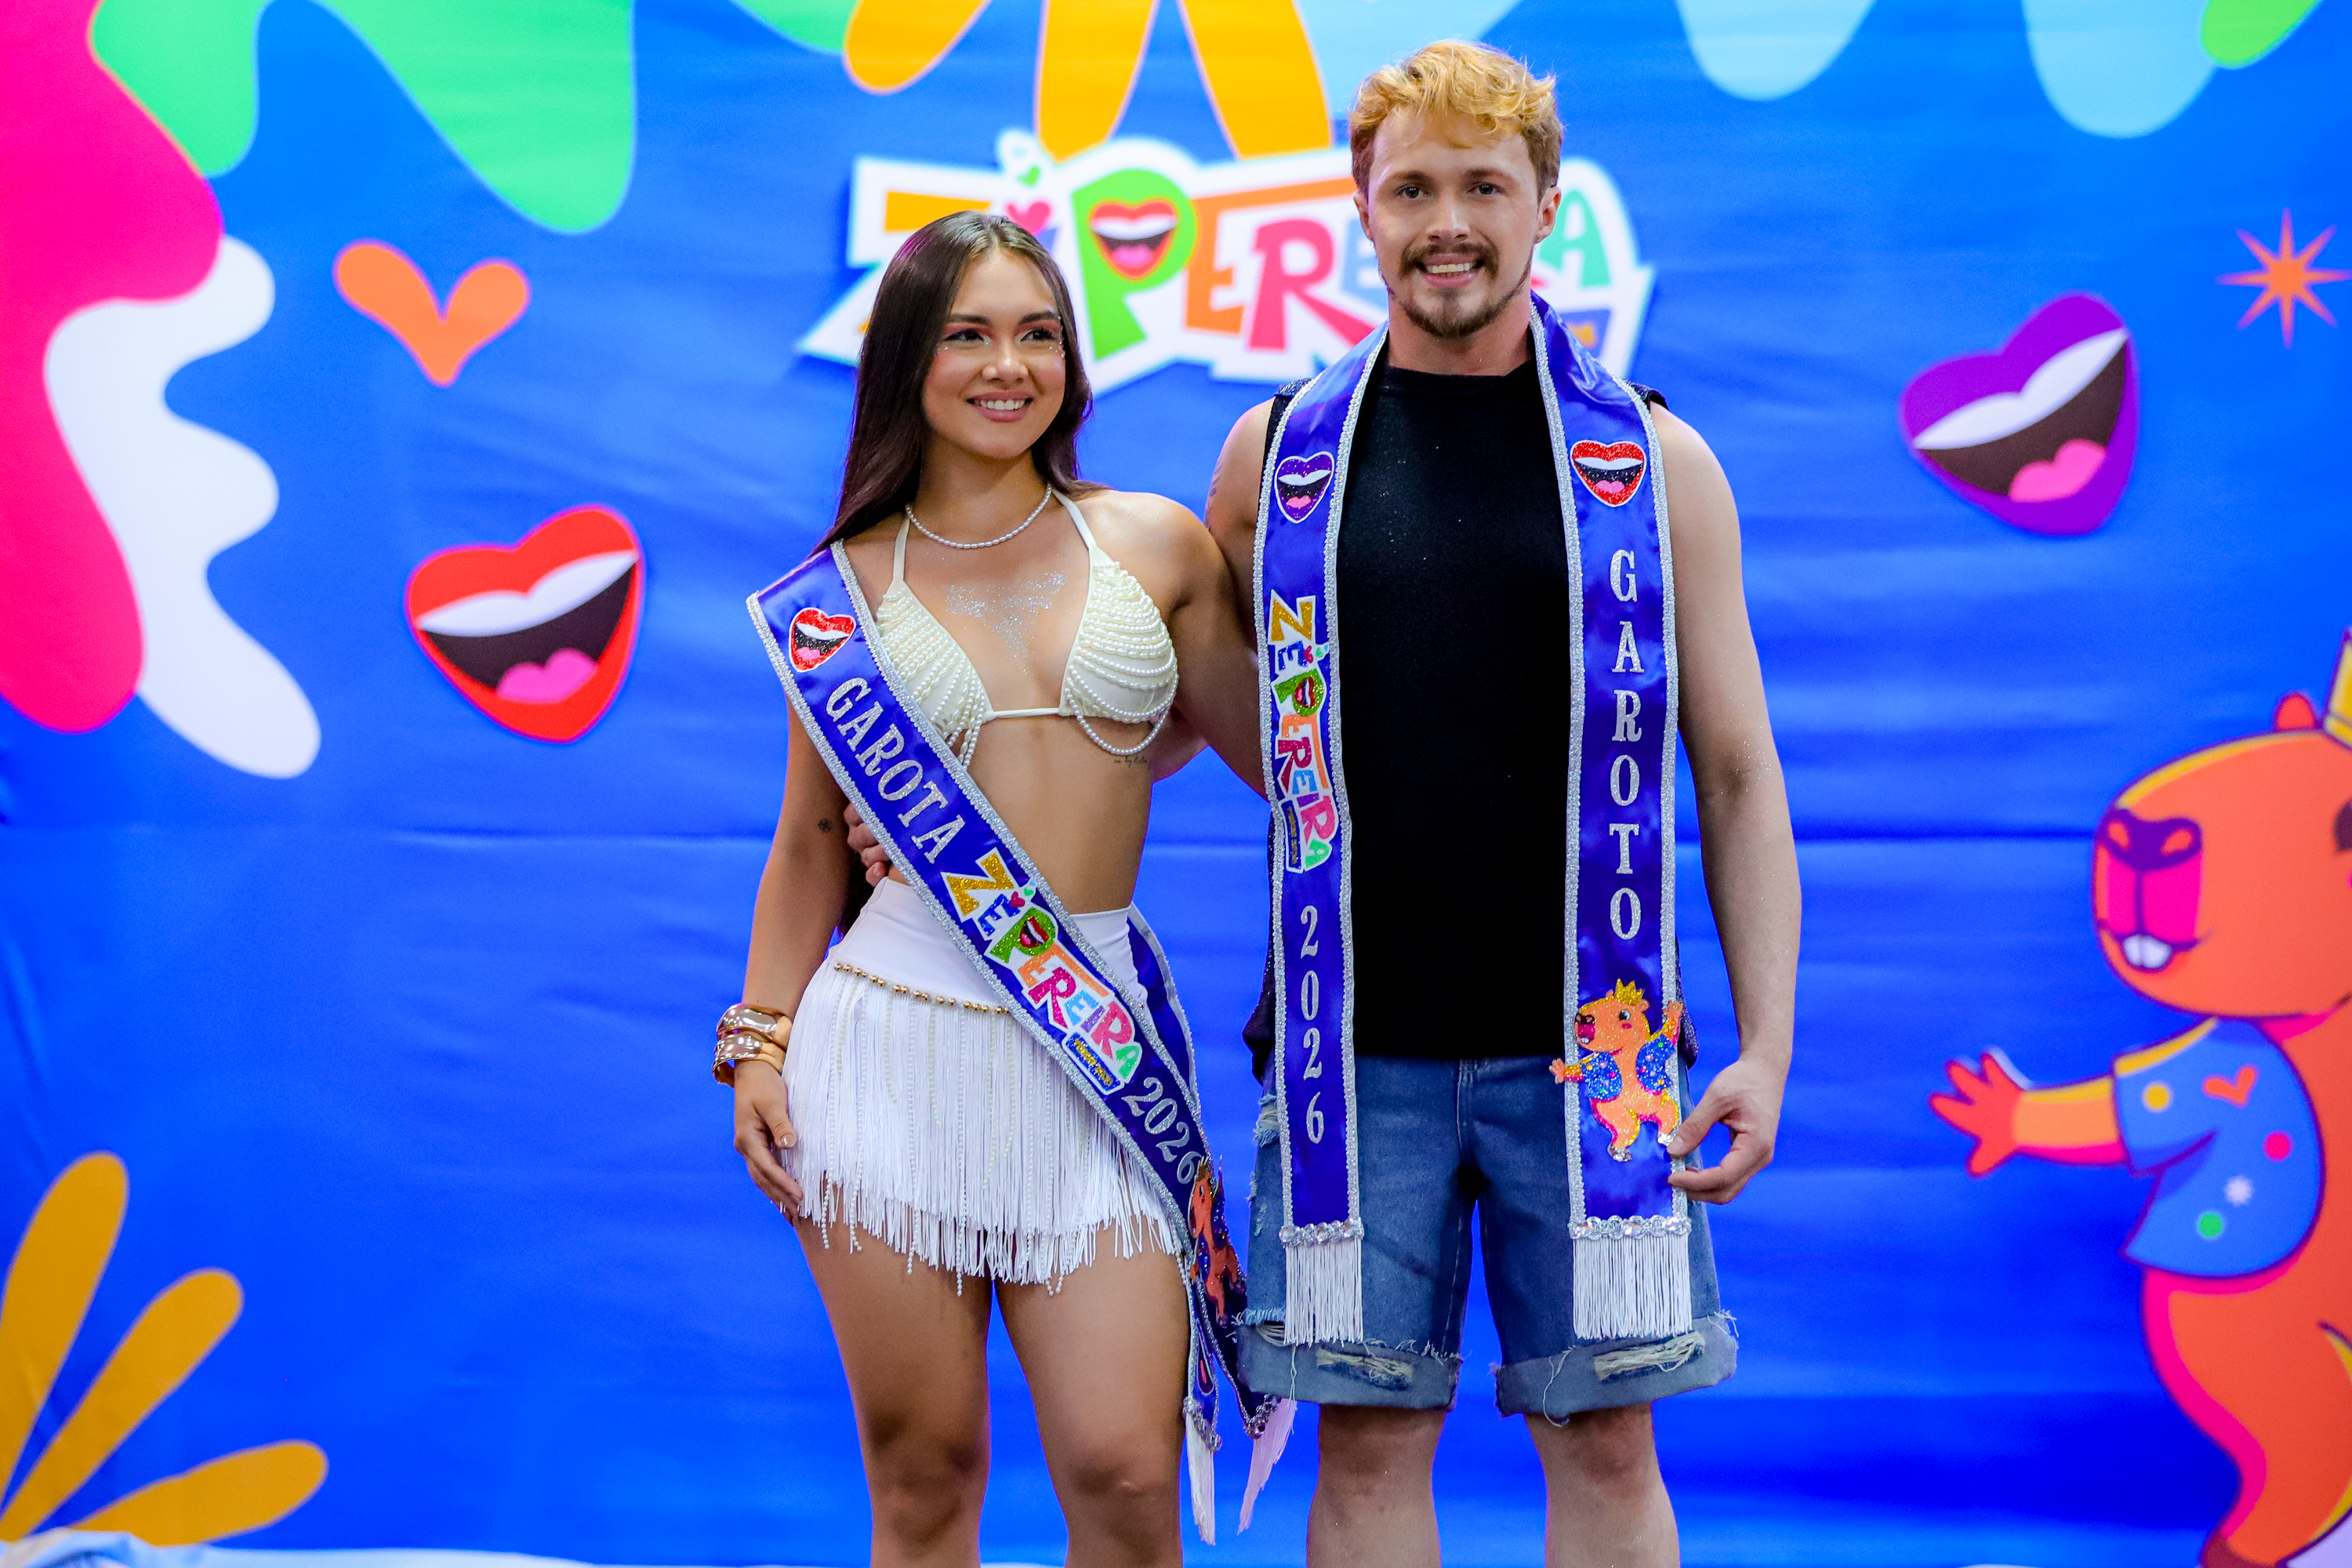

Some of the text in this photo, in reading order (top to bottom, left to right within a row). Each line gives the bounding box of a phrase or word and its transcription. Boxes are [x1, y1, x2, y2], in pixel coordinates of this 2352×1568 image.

[1073, 167, 1612, 361] PEREA
[1274, 669, 1335, 868] PEREIRA
[1609, 549, 1645, 940] GAROTO
[826, 677, 966, 864] GAROTA
[989, 906, 1139, 1080] PEREIRA
[1121, 1076, 1202, 1185] 2026
[1301, 905, 1324, 1144] 2026
